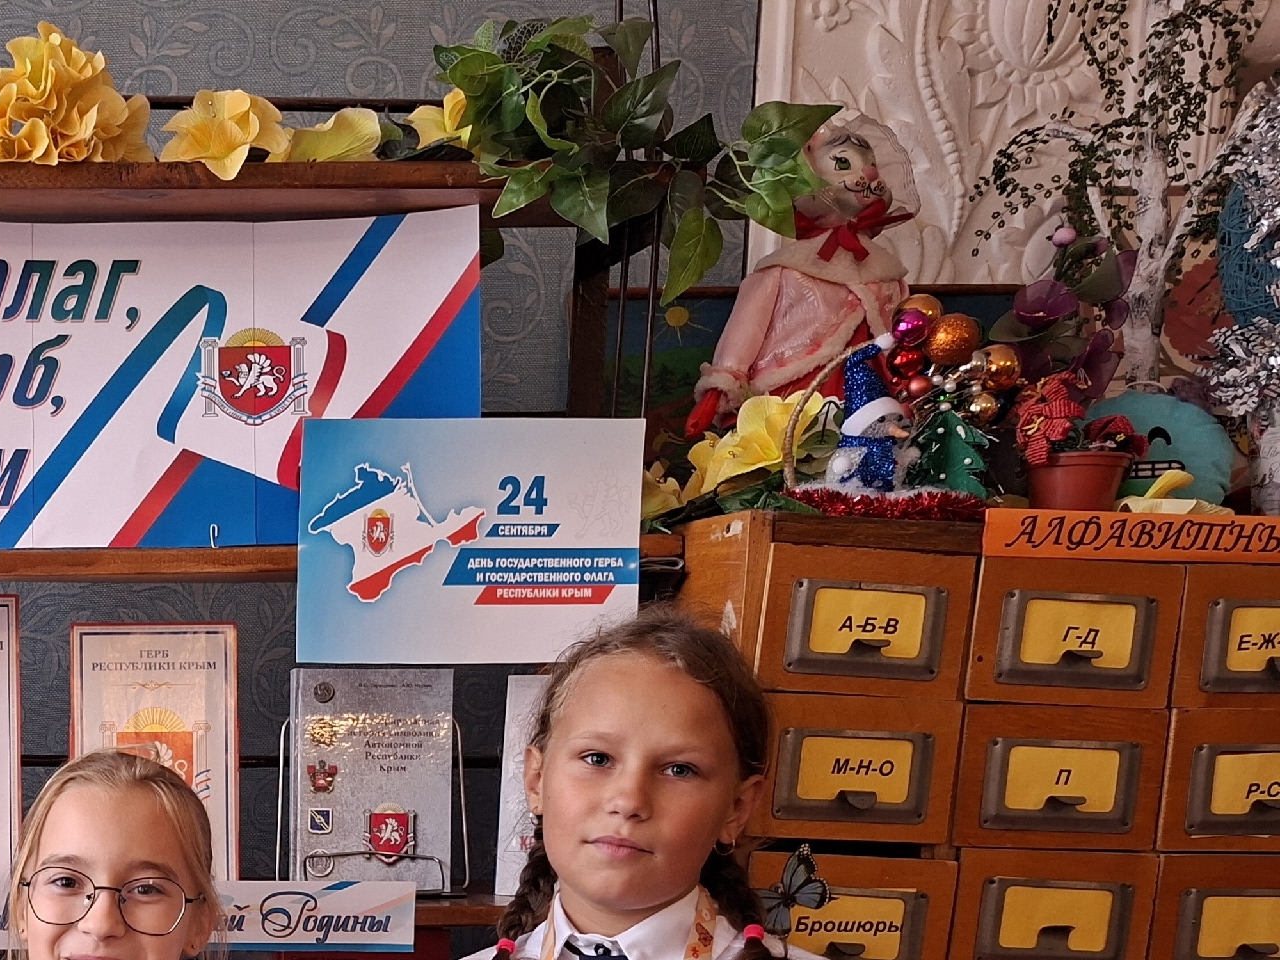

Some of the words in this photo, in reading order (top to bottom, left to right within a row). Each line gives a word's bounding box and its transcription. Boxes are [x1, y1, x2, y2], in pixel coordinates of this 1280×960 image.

[497, 475, 548, 516] 24
[498, 525, 548, 536] СЕНТЯБРЯ
[468, 558, 493, 569] ДЕНЬ
[496, 558, 591, 569] ГОСУДАРСТВЕННОГО
[594, 557, 623, 568] ГЕРБА
[476, 572, 483, 582] И
[485, 572, 581, 583] ГОСУДАРСТВЕННОГО
[583, 572, 614, 582] ФЛАГА
[497, 588, 559, 598] РЕСПУБЛИКИ
[561, 588, 592, 598] КРЫМ
[838, 615, 900, 635] А-Б-В
[1062, 626, 1100, 649] Г-Д
[139, 649, 169, 660] ГЕРБ
[91, 660, 175, 671] РЕСПУБЛИКИ
[178, 661, 217, 671] КРЫМ
[831, 758, 895, 777] М-Н-О
[1055, 769, 1071, 786] П
[260, 891, 391, 943] Родины
[795, 915, 903, 937] Брошюры
